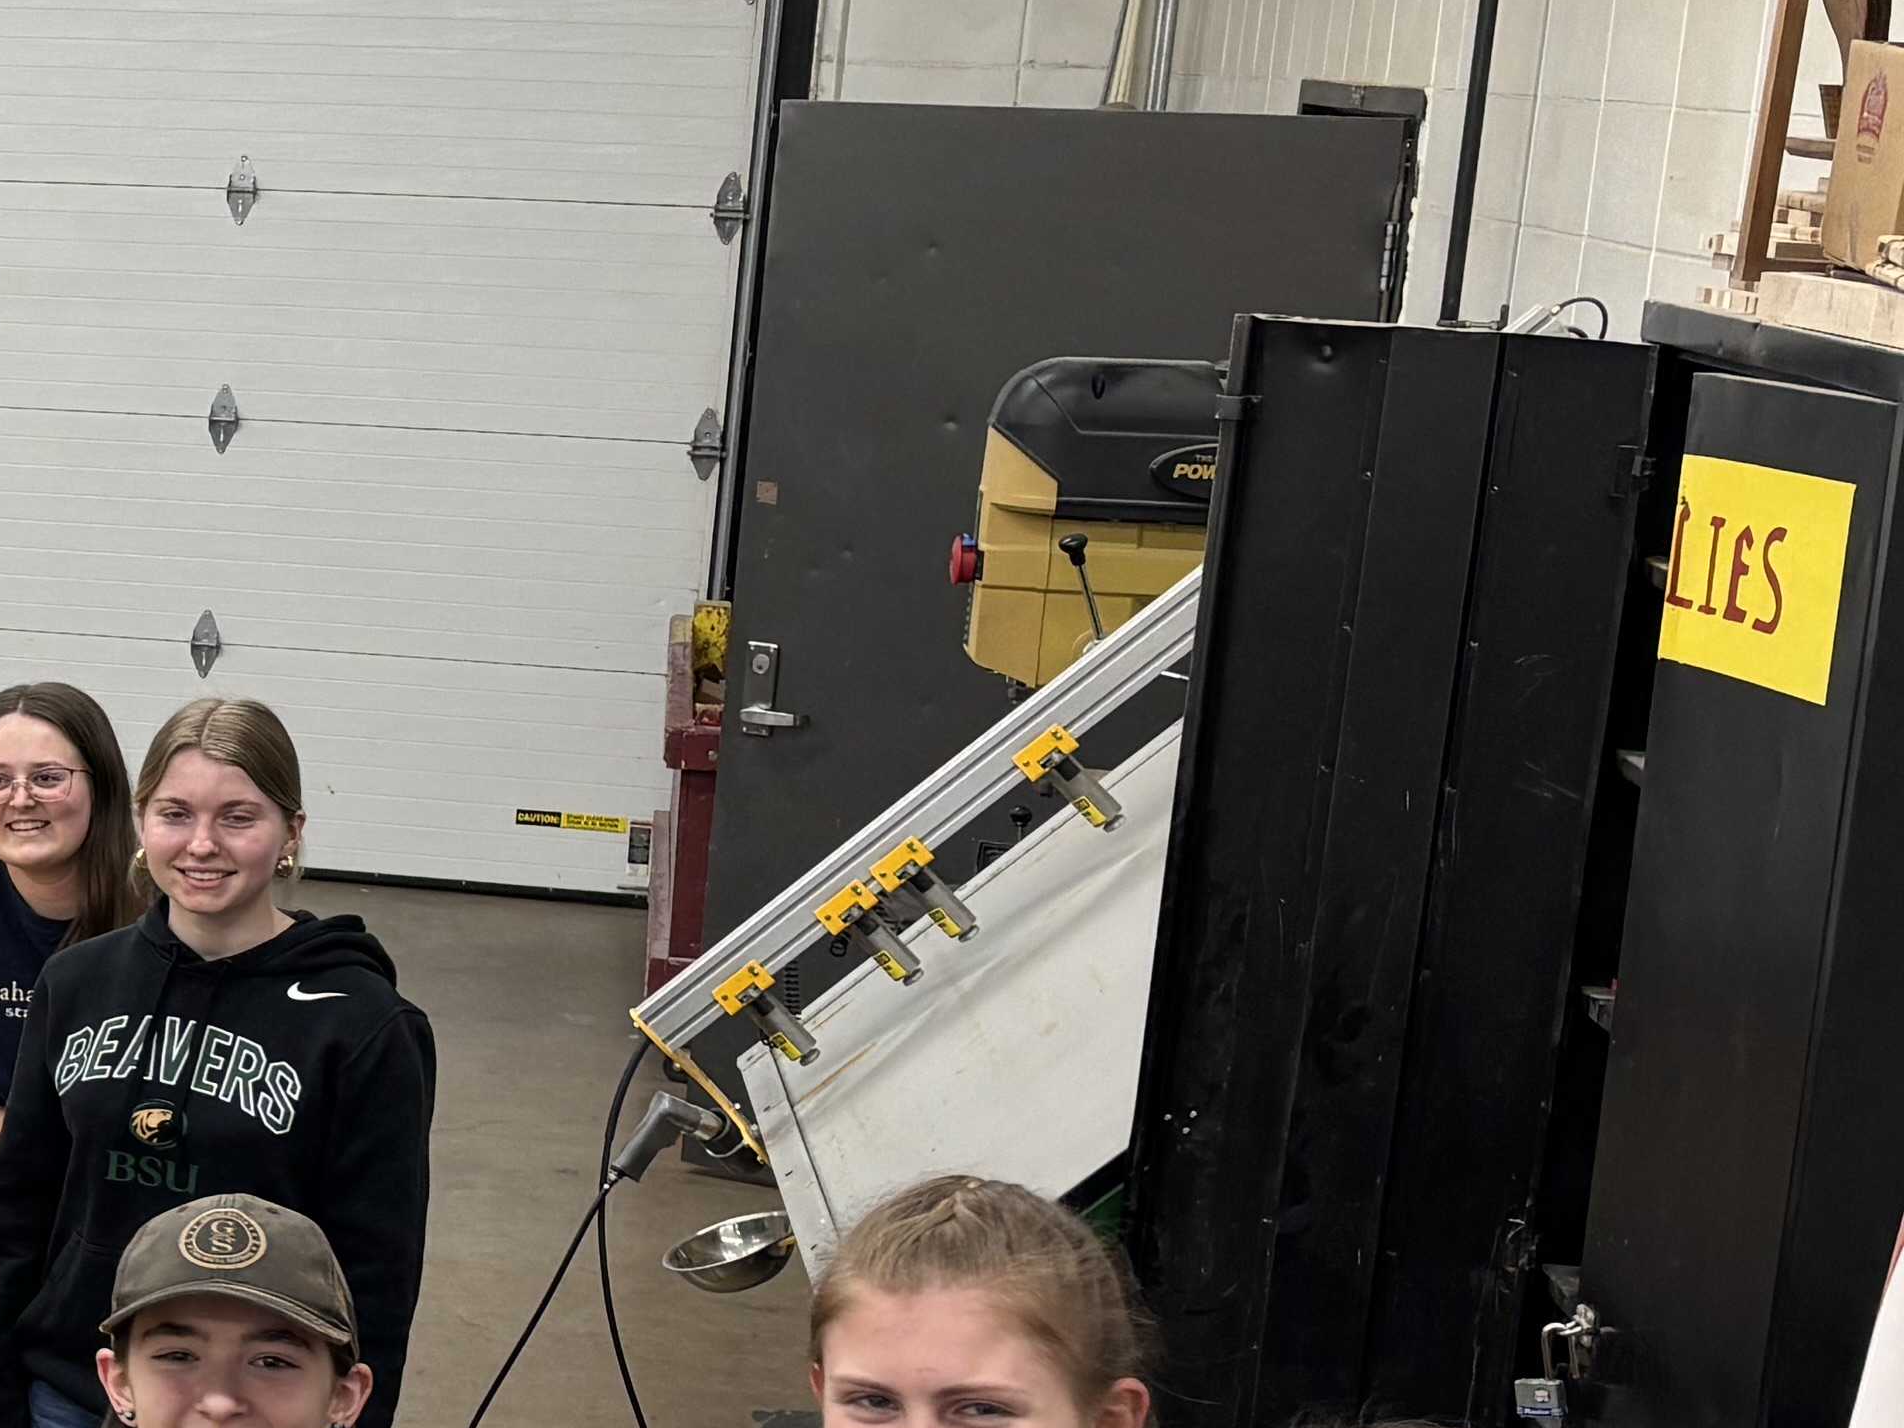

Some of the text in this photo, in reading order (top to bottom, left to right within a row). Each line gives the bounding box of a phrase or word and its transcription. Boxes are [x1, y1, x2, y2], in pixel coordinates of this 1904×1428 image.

[1666, 505, 1788, 635] LIES
[55, 1015, 302, 1135] BEAVERS
[104, 1149, 199, 1196] BSU
